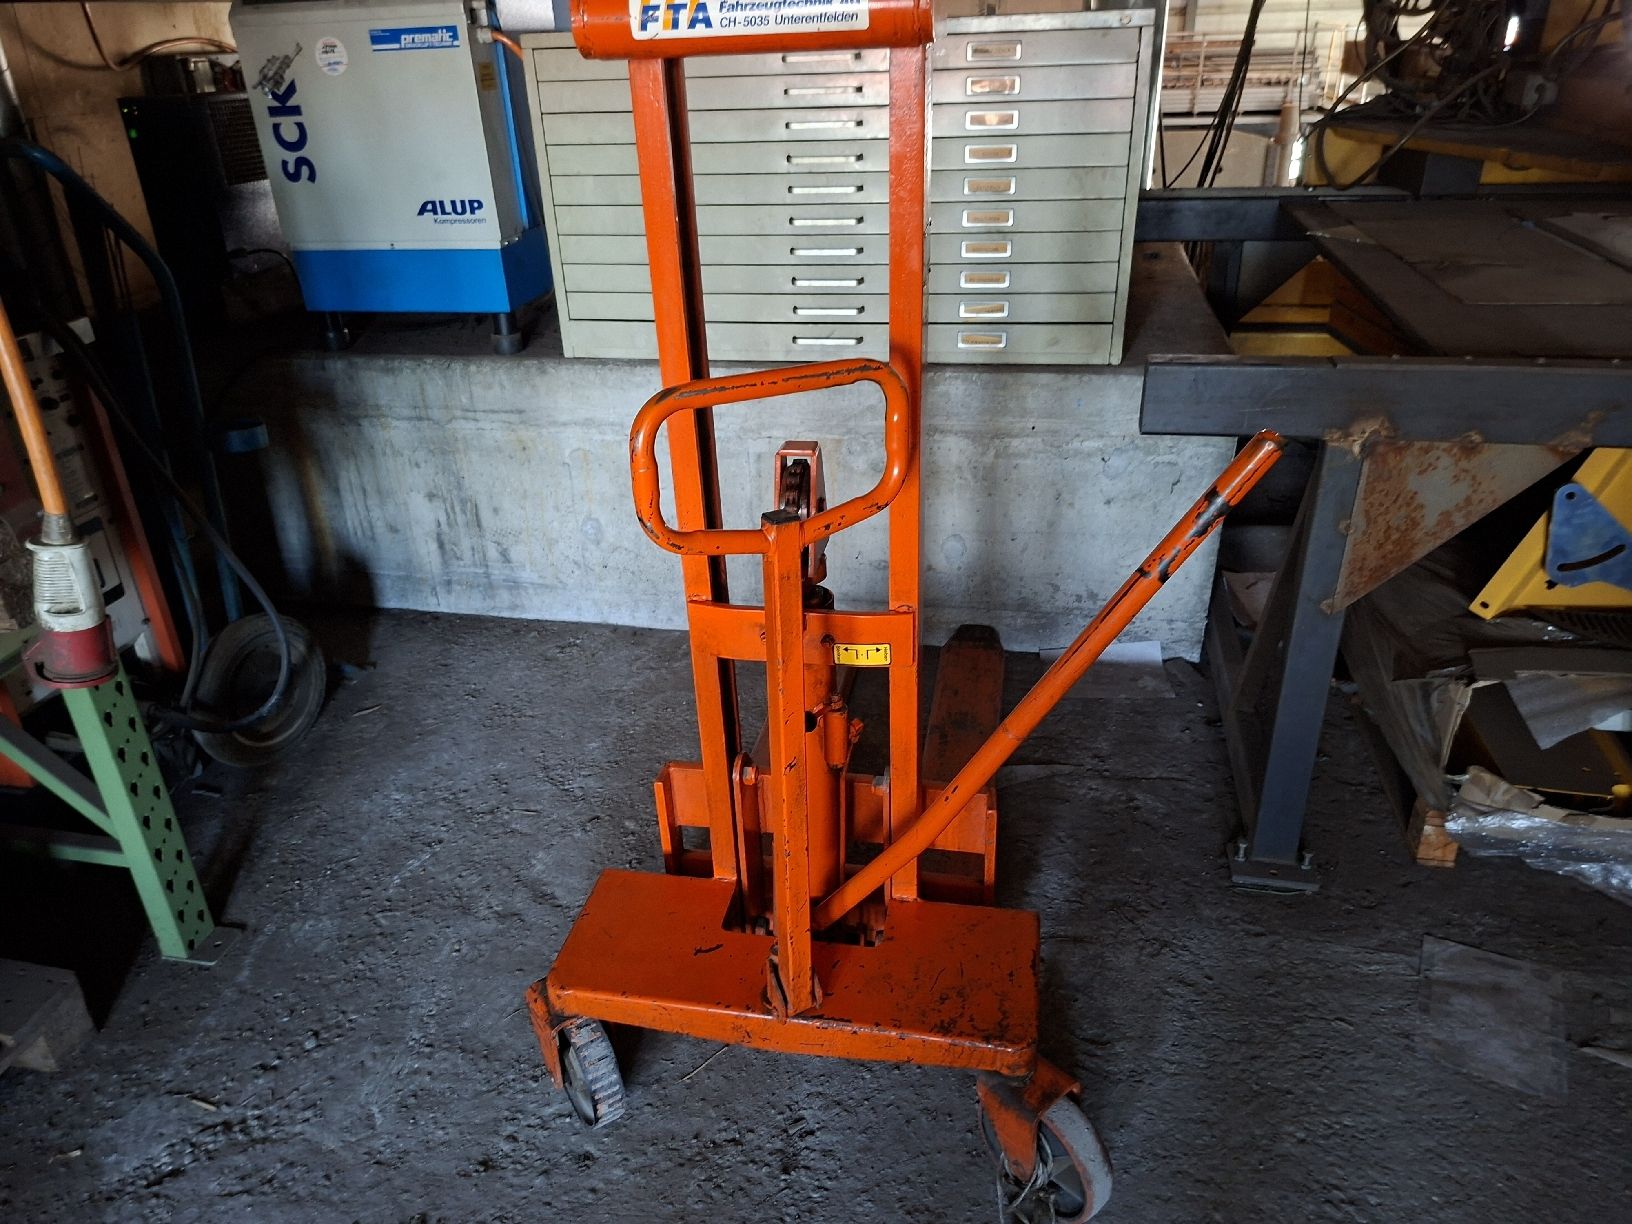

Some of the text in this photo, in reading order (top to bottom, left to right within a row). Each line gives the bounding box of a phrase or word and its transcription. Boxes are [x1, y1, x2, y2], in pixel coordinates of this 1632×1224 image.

[639, 2, 713, 31] FTA
[774, 11, 859, 25] Unterentfelden
[401, 29, 453, 47] prematic
[267, 78, 316, 184] SCK
[417, 200, 484, 216] ALUP
[433, 217, 487, 226] Kompressoren
